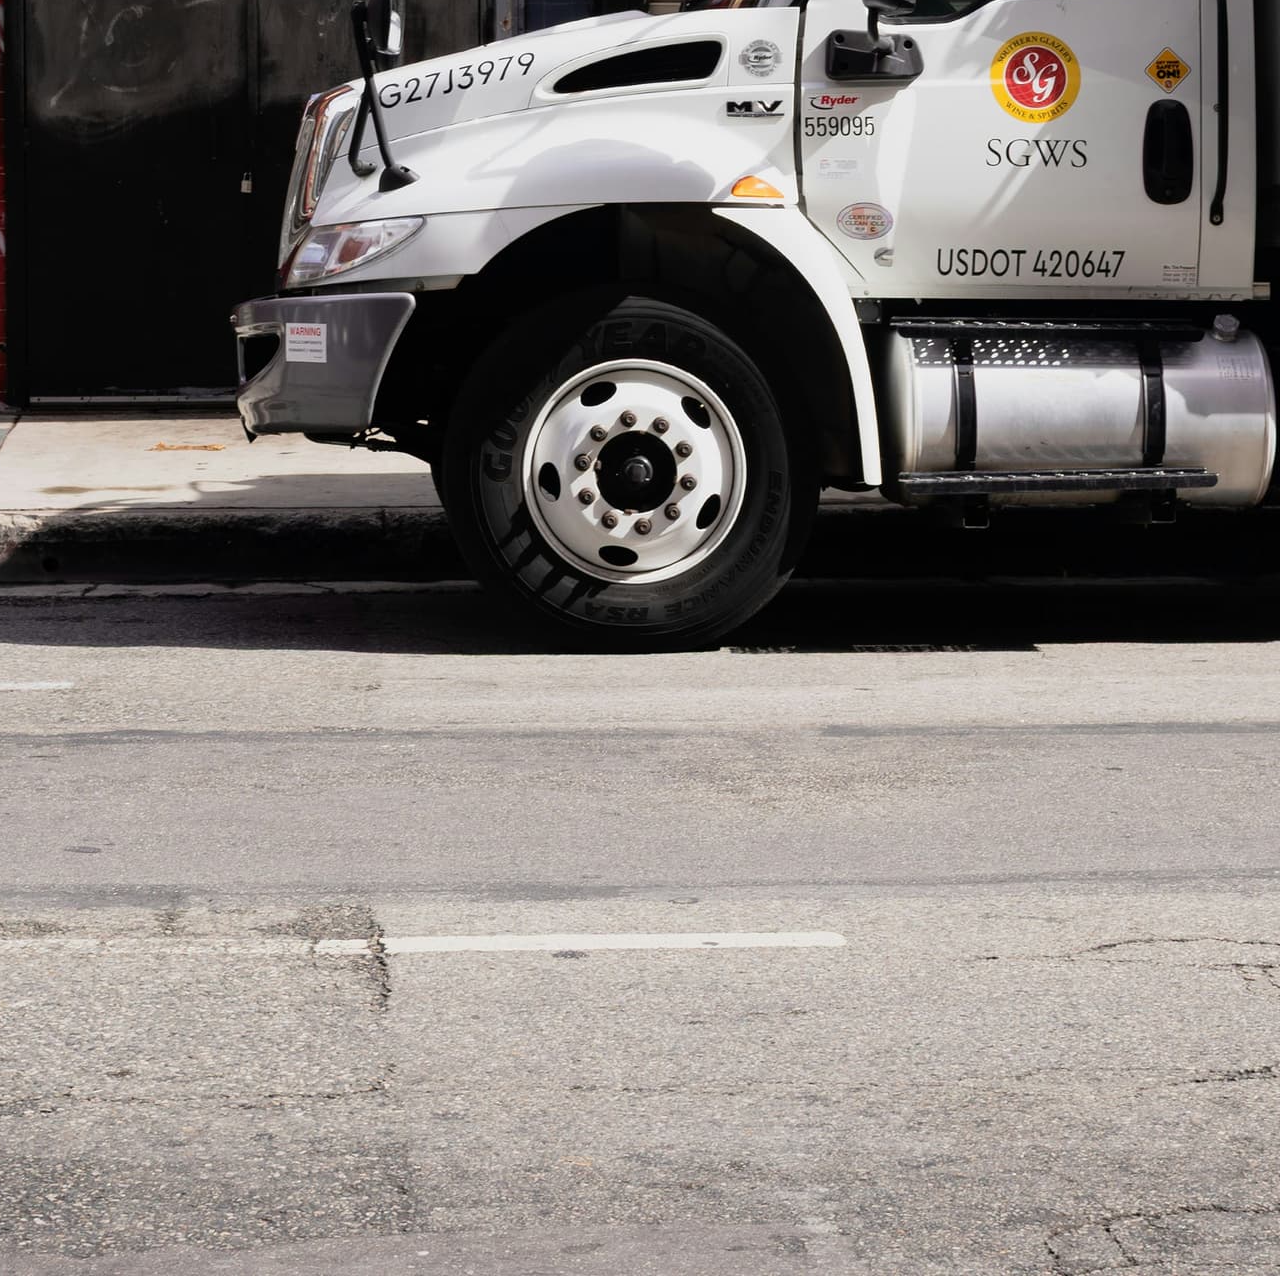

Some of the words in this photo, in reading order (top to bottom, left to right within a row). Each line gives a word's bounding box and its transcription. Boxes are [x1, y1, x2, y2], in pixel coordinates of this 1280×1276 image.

[997, 35, 1039, 63] SOUTHERN
[379, 52, 535, 109] G27J3979
[1012, 51, 1058, 103] SG
[1156, 69, 1180, 80] ON!
[820, 94, 858, 107] Ryder
[1005, 100, 1027, 119] WINE
[1028, 112, 1035, 120] &
[1037, 99, 1069, 121] SPIRITS
[804, 116, 875, 137] 559095
[985, 138, 1088, 168] SGWS
[937, 248, 1027, 277] USDOT
[1032, 249, 1126, 278] 420647
[289, 326, 322, 337] WARNING
